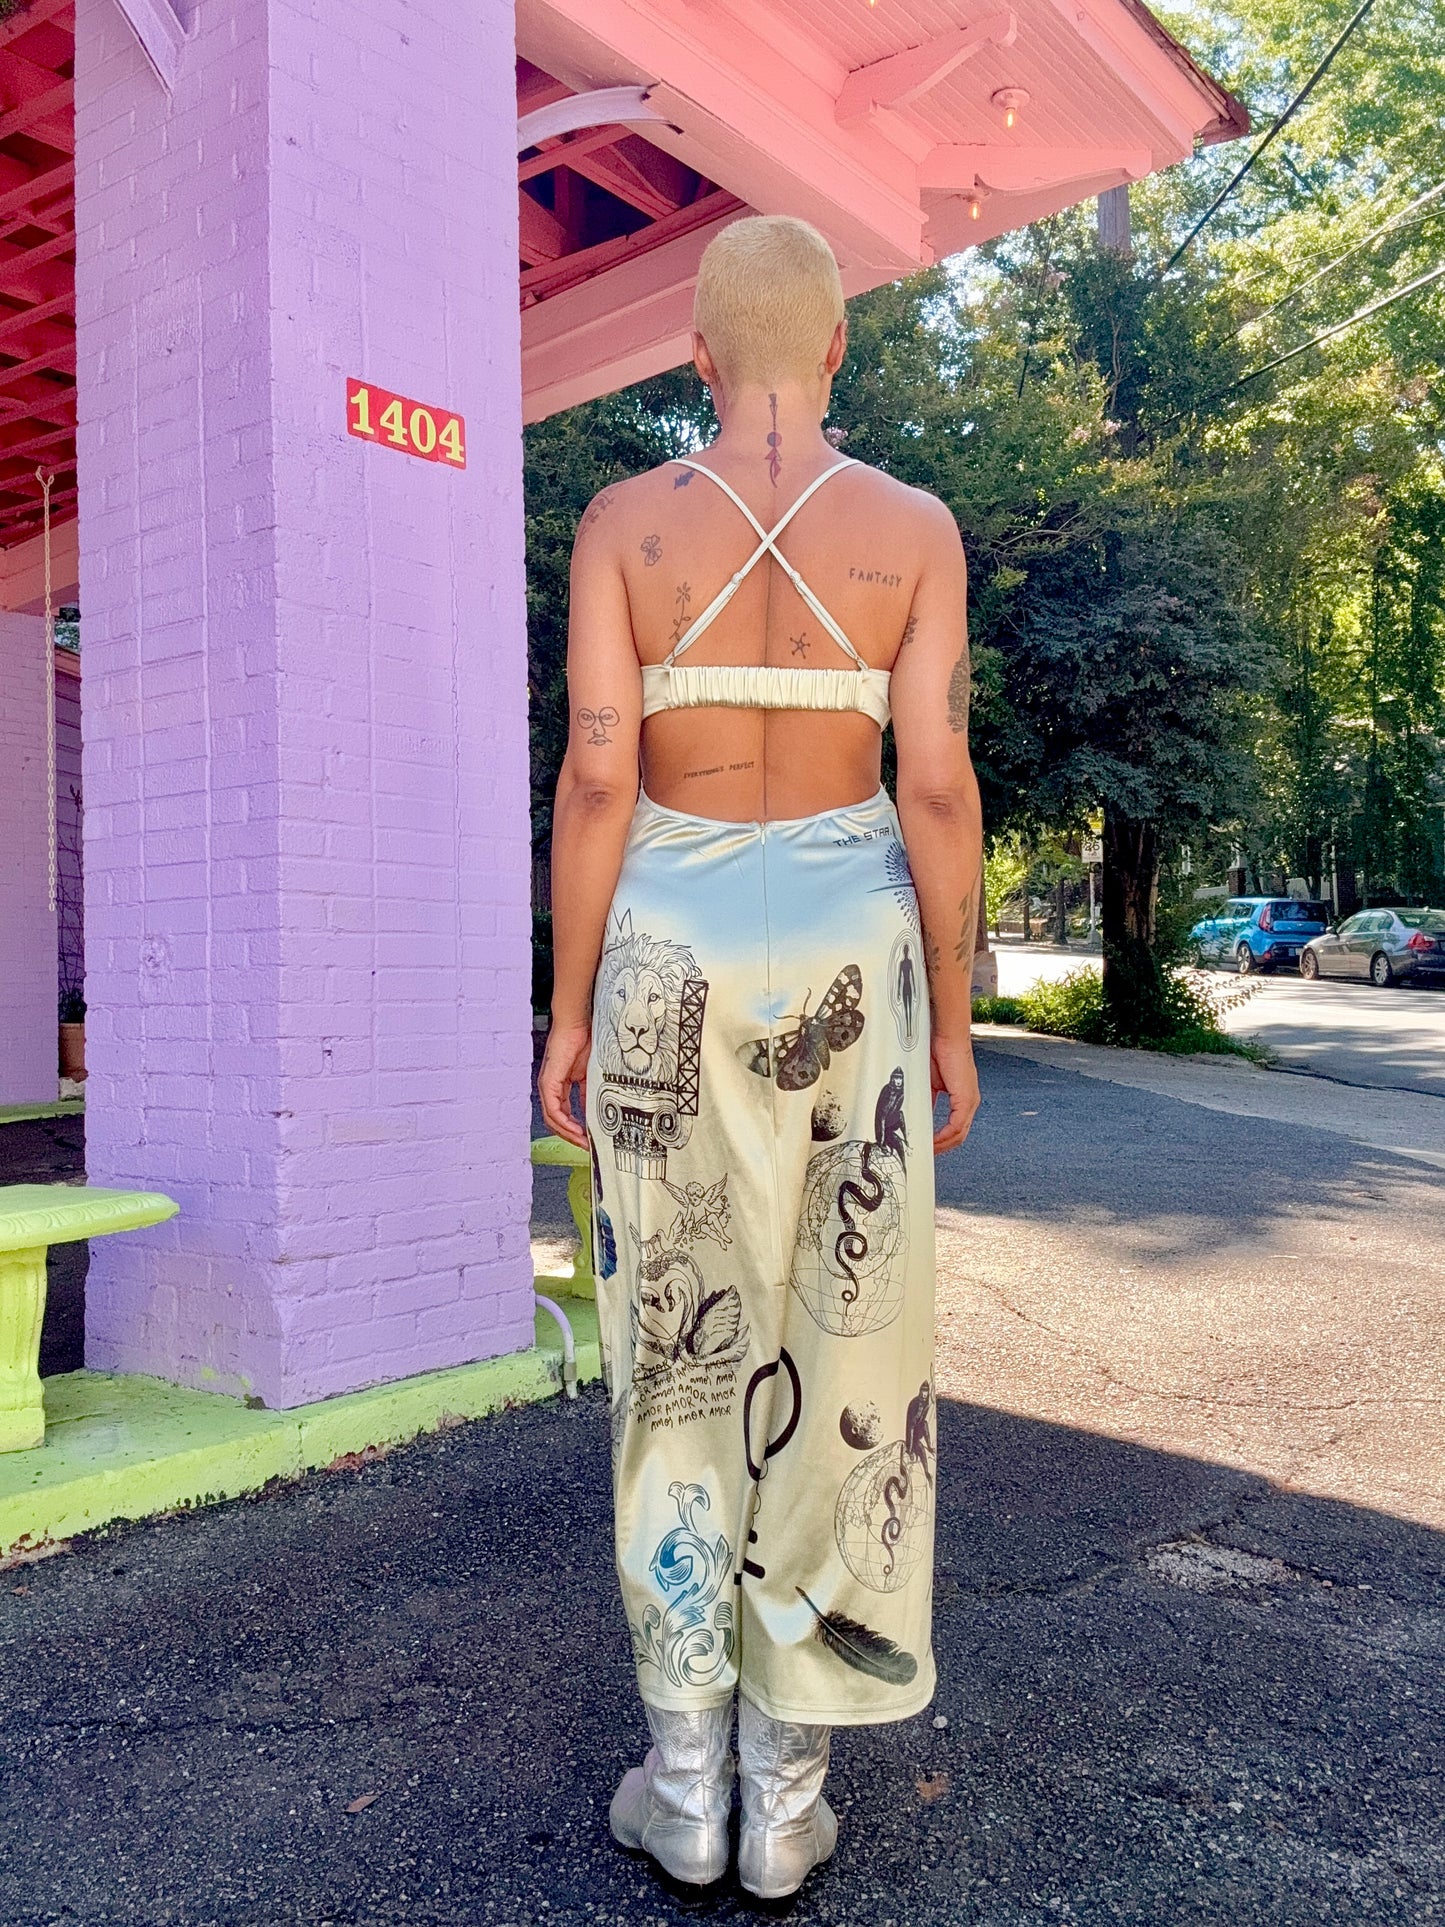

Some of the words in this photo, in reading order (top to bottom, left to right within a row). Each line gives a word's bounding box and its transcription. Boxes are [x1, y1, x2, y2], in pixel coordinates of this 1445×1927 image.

[350, 387, 465, 463] 1404
[849, 567, 902, 588] FANTASY
[729, 761, 754, 771] PERFECT
[832, 835, 861, 847] THE
[678, 1383, 708, 1404] AMOR
[637, 1404, 663, 1424] AMOR
[666, 1396, 696, 1416] AMOR
[711, 1386, 736, 1402] AMOR
[678, 1408, 707, 1426] AMOR
[709, 1404, 732, 1417] AMOR
